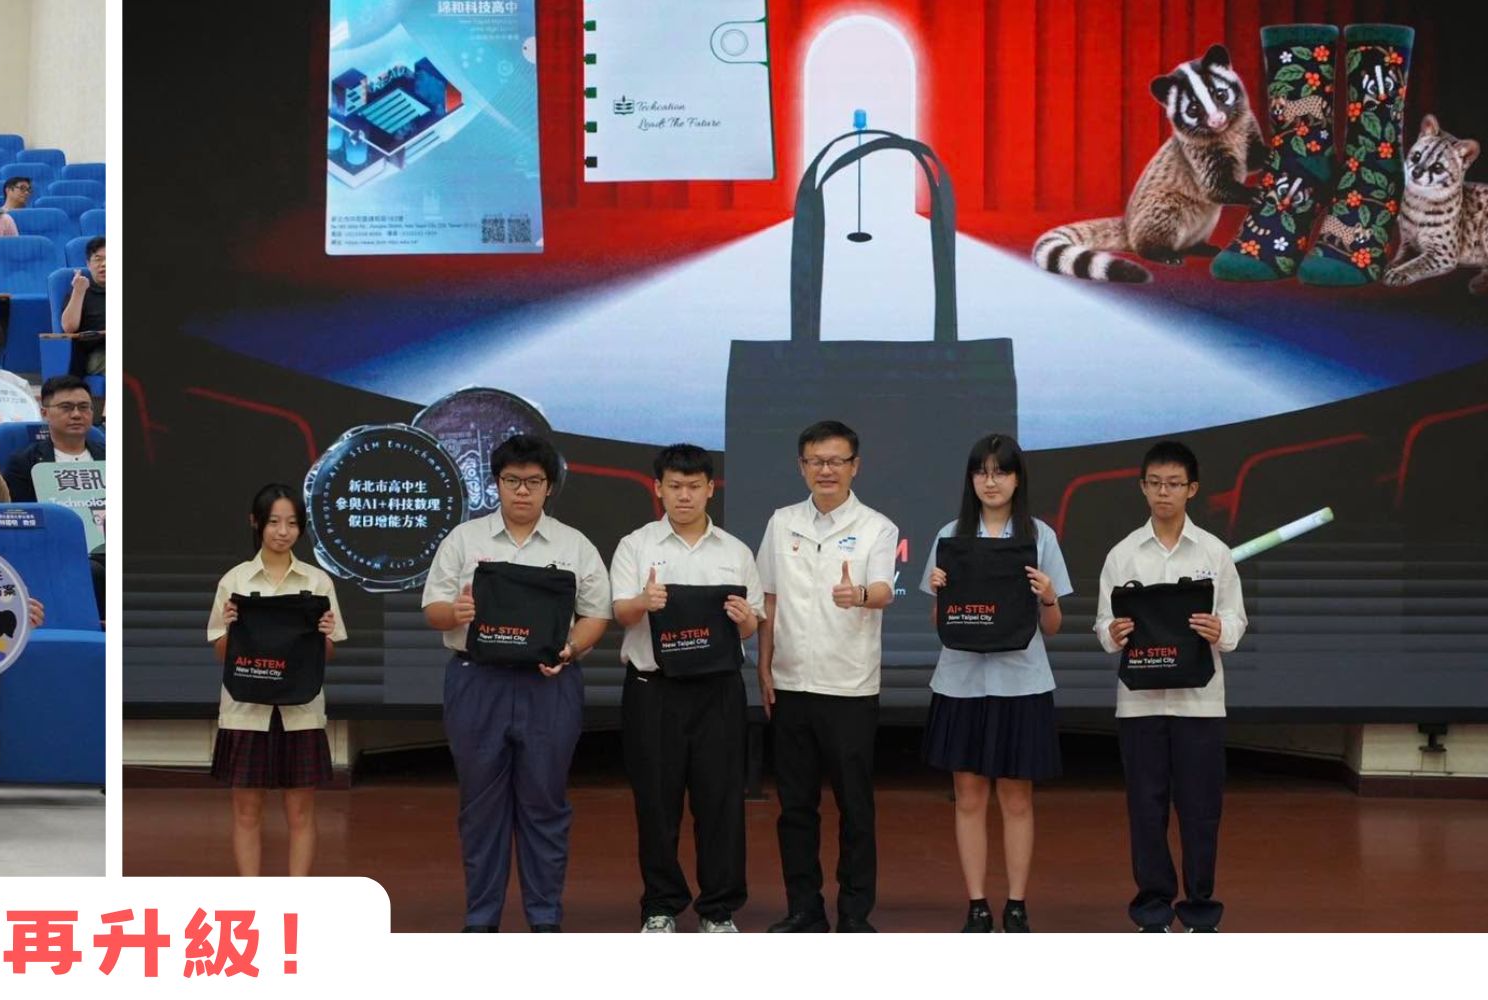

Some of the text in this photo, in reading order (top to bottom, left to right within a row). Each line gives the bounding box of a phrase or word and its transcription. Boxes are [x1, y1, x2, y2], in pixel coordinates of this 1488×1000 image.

[53, 468, 106, 491] 資訊
[348, 479, 428, 494] 新北市高中生
[335, 497, 441, 511] 參與AI+科技數理
[348, 514, 428, 529] 假日增能方案
[965, 604, 995, 614] STEM
[498, 626, 529, 636] STEM
[680, 628, 710, 639] STEM
[1147, 647, 1177, 657] STEM
[255, 658, 286, 669] STEM
